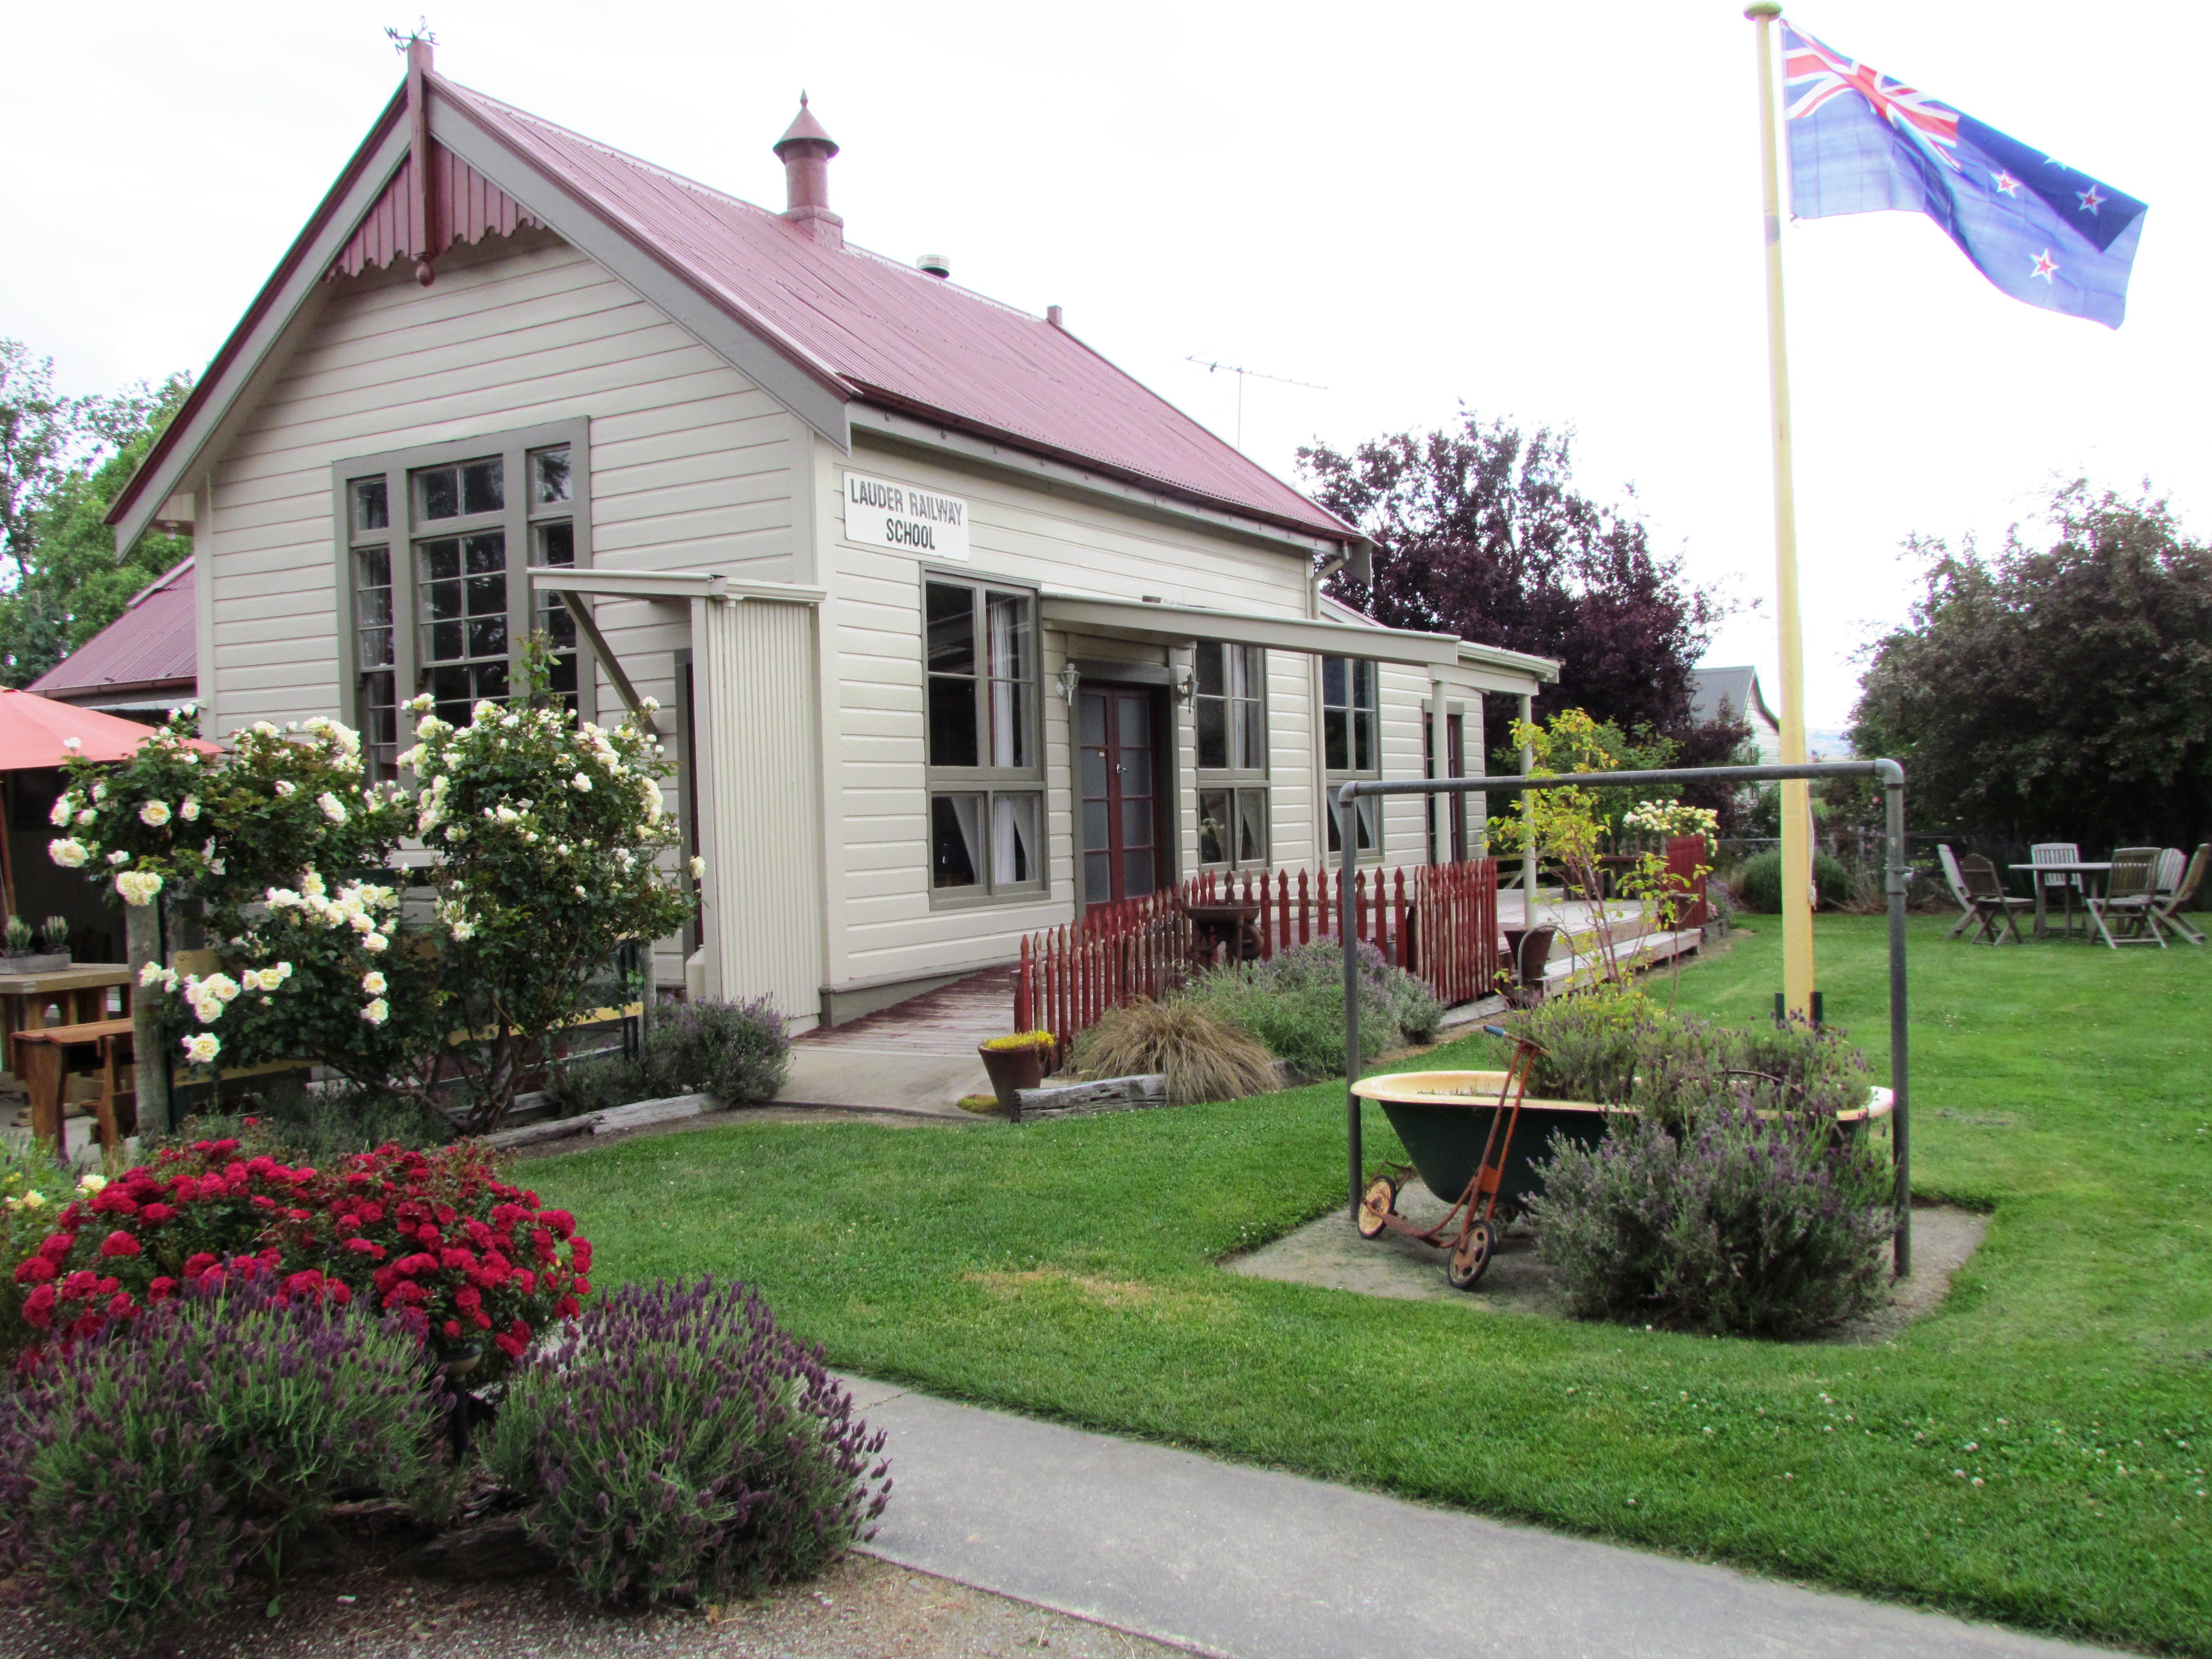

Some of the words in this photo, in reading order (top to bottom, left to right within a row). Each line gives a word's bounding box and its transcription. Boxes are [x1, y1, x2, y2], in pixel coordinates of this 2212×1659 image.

[383, 26, 398, 40] W
[428, 31, 441, 46] E
[394, 38, 406, 56] N
[850, 478, 904, 514] LAUDER
[908, 492, 962, 526] RAILWAY
[886, 518, 935, 551] SCHOOL
